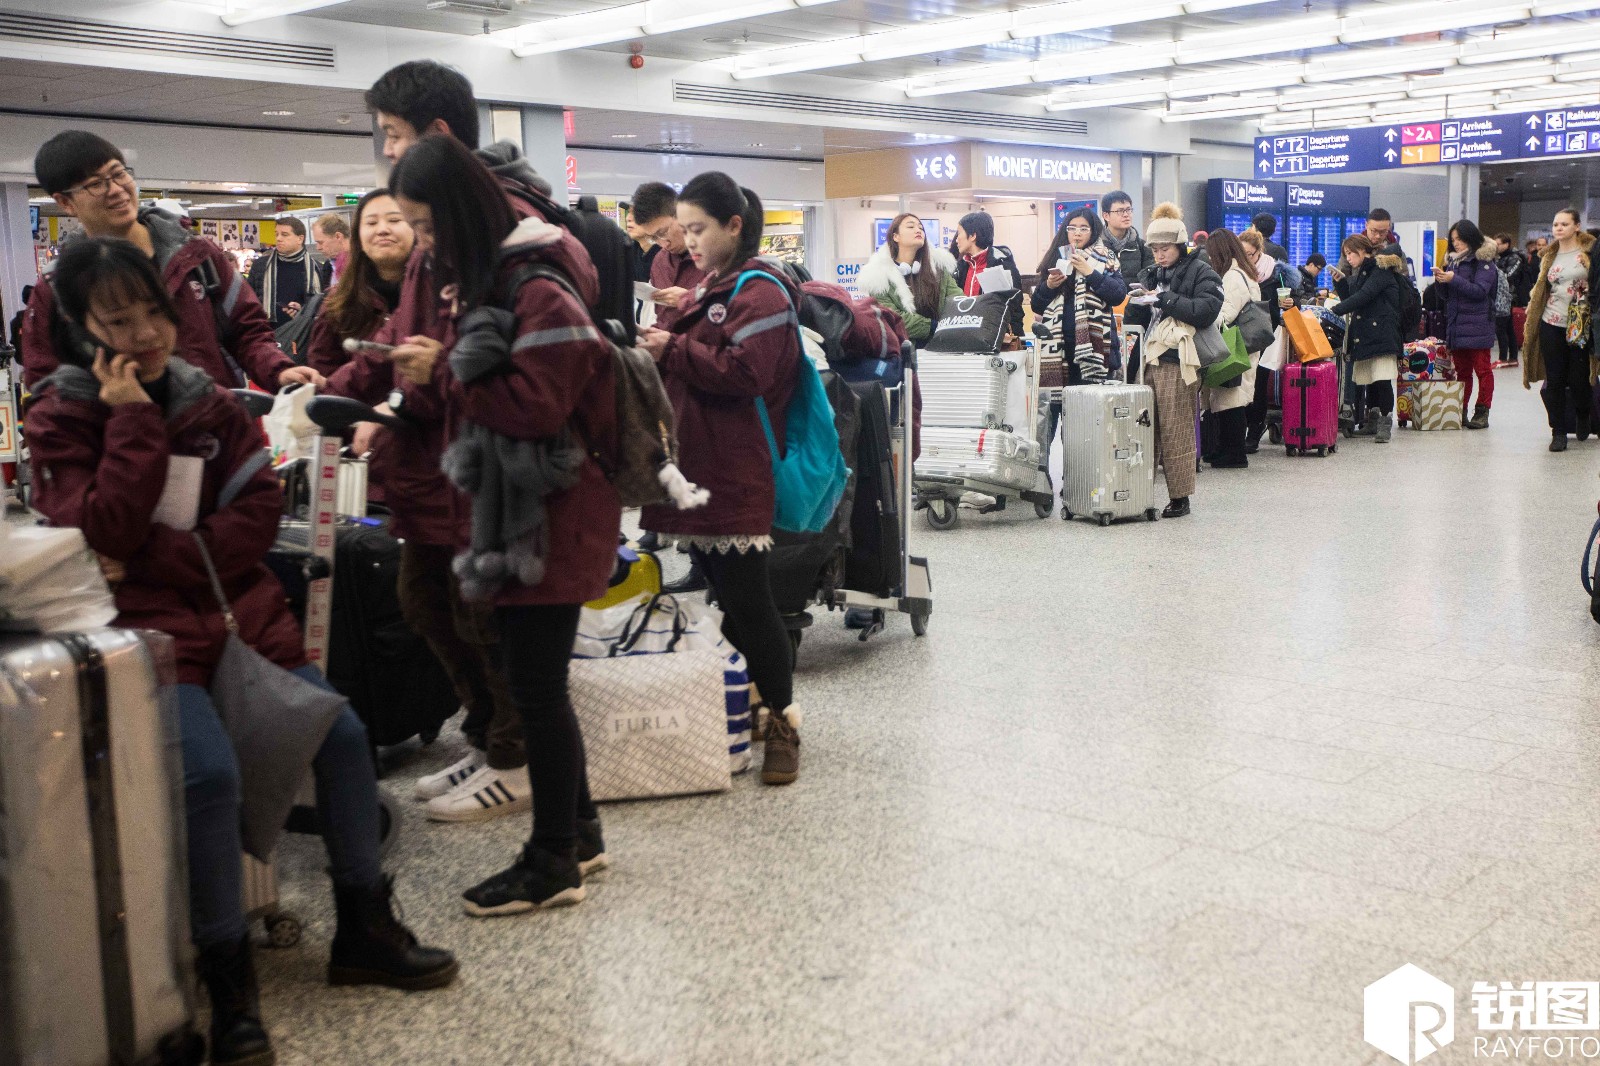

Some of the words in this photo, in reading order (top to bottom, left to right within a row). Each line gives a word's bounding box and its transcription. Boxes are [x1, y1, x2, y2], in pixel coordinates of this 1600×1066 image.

[1461, 120, 1493, 131] Arrivals
[1416, 127, 1434, 141] 2A
[1287, 139, 1304, 152] T2
[1309, 135, 1350, 146] Departures
[1417, 147, 1424, 161] 1
[1461, 141, 1493, 152] Arrivals
[986, 155, 1038, 178] MONEY
[1040, 159, 1111, 182] EXCHANGE
[1287, 158, 1303, 171] T1
[1309, 155, 1350, 166] Departures
[1248, 185, 1267, 195] Arrivals
[1299, 187, 1324, 198] Departures
[615, 715, 680, 733] FURLA
